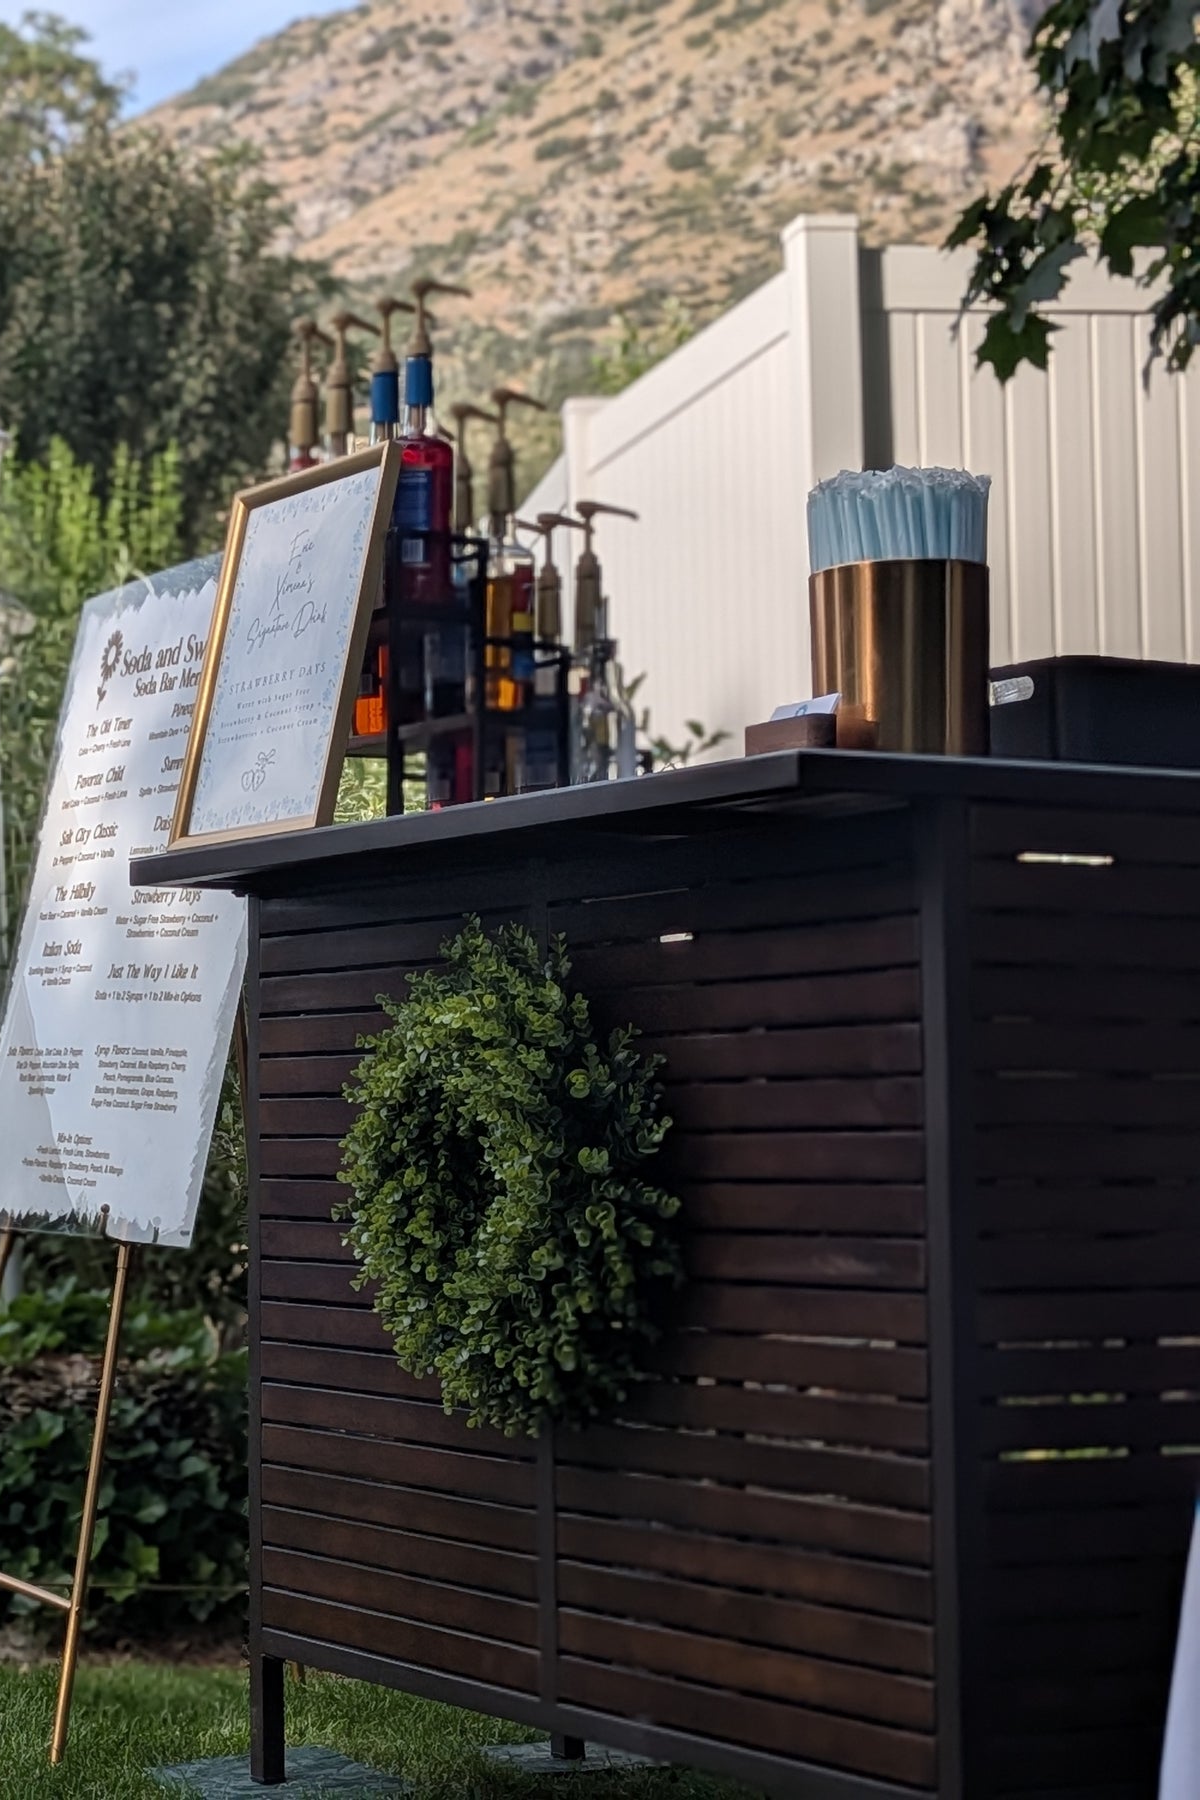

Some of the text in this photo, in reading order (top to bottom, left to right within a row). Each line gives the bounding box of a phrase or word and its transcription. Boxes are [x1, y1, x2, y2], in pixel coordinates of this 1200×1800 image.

[246, 600, 328, 656] Signature Drink
[120, 644, 153, 678] Soda
[155, 636, 184, 670] and
[133, 674, 158, 698] Soda
[159, 671, 179, 694] Bar
[228, 661, 327, 696] STRAWBERRY DAYS
[86, 723, 99, 739] The
[100, 718, 113, 736] Old
[105, 764, 126, 783] Child
[75, 827, 91, 845] City
[93, 821, 119, 840] Classic
[54, 886, 67, 902] The
[131, 886, 203, 907] Strawberry Days
[63, 938, 83, 957] Soda
[107, 963, 199, 983] Just The Way I Like It
